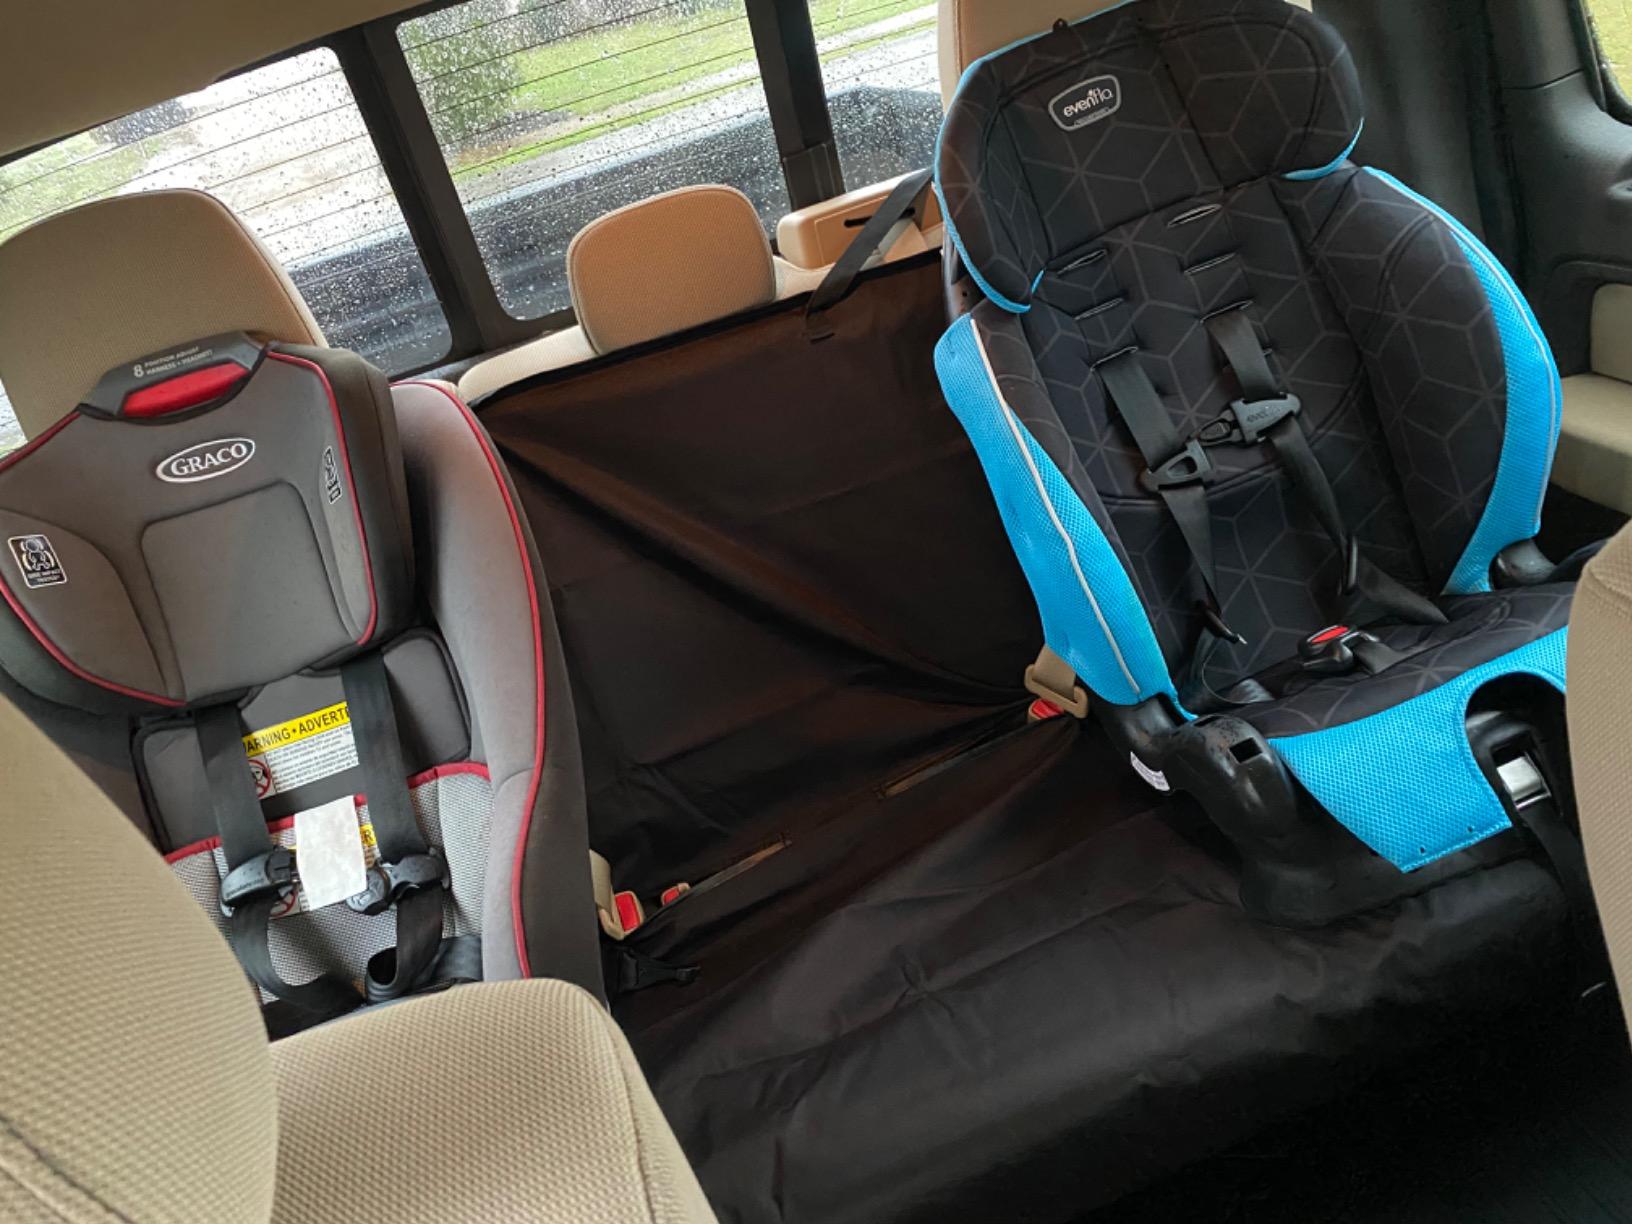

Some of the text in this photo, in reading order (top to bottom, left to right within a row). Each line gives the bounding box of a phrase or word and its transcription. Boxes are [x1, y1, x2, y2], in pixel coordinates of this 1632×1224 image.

[133, 364, 145, 377] 8
[171, 443, 247, 475] GRACO
[243, 727, 291, 753] ARNING
